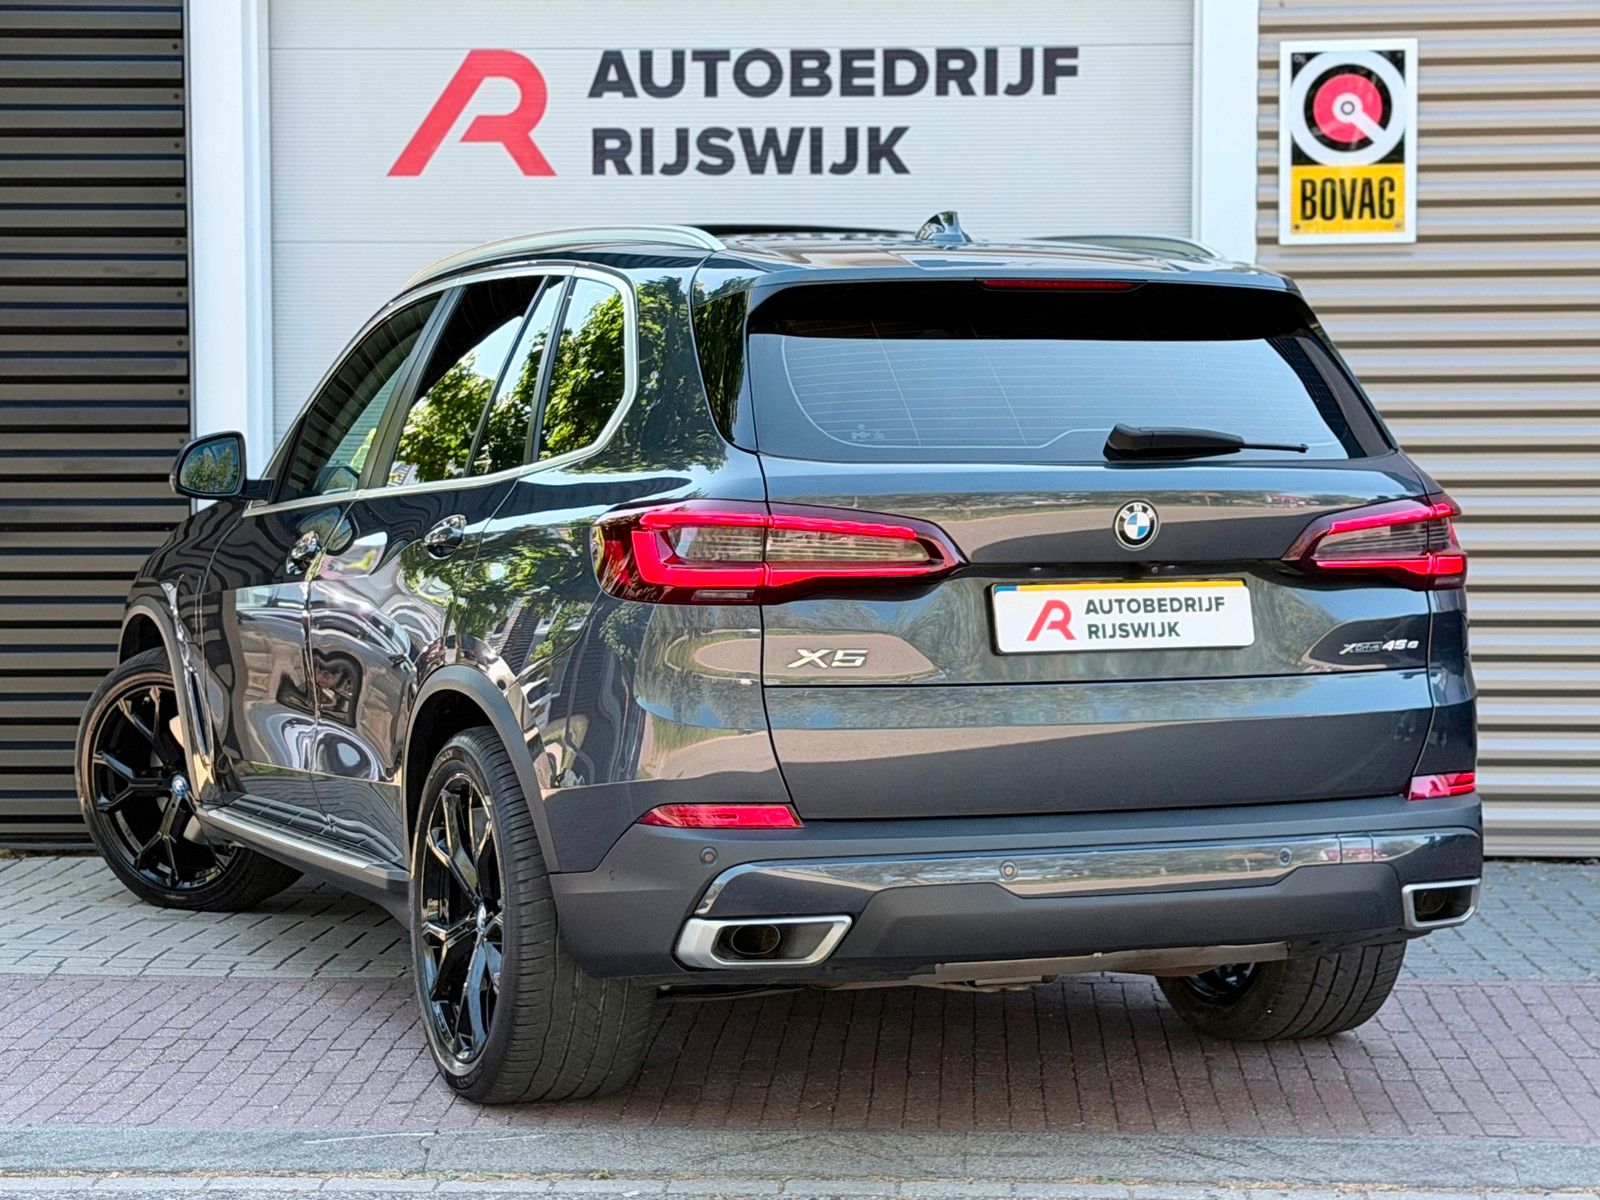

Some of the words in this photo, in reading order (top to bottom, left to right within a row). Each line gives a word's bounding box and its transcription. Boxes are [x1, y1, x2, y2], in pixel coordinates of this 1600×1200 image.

[587, 46, 1079, 98] AUTOBEDRIJF
[592, 126, 911, 176] RIJSWIJK
[1300, 176, 1396, 221] BOVAG
[1084, 596, 1226, 615] AUTOBEDRIJF
[1087, 621, 1181, 640] RIJSWIJK
[787, 648, 869, 668] X5
